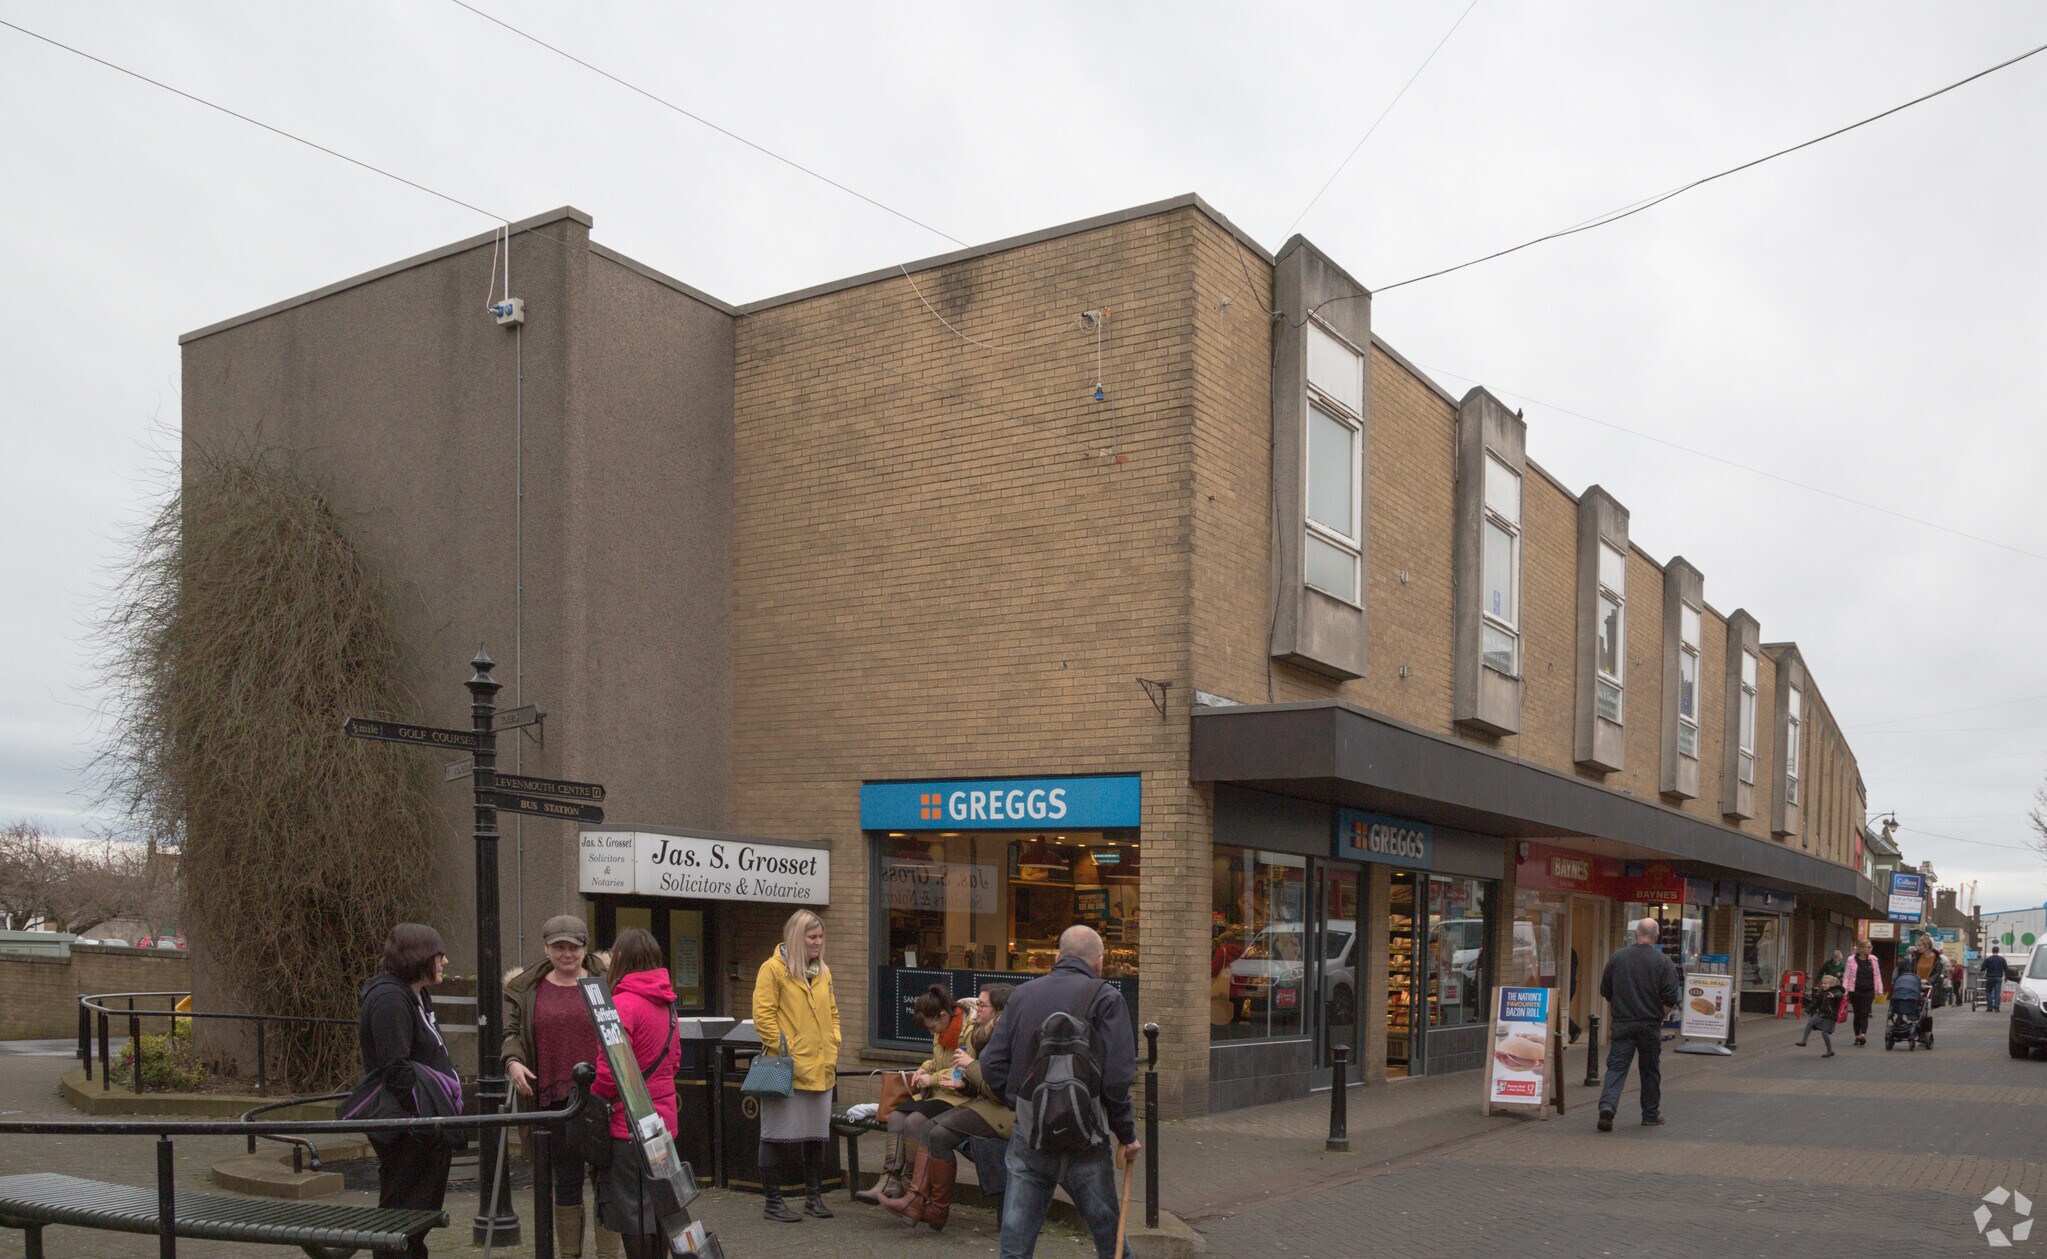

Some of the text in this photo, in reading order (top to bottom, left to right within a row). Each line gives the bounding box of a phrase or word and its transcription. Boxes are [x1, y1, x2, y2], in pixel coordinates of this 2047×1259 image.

[359, 724, 379, 735] mile
[399, 727, 477, 746] GOLF COURSES
[496, 778, 590, 796] LEVENMOUTH CENTRE
[520, 800, 580, 816] BUS STATION
[948, 788, 1067, 821] GREGGS
[581, 836, 632, 849] Jas. S. Grosset
[1368, 823, 1424, 859] GREGGS
[588, 853, 625, 864] Solicitors
[651, 839, 817, 876] Jas. S. Grosset
[604, 866, 611, 875] &
[591, 877, 625, 888] Notaries
[660, 872, 811, 899] Solicitors & Notaries
[1896, 878, 1917, 886] Colliers
[584, 983, 605, 1006] Will
[1507, 991, 1542, 1002] THE NATION'S
[593, 1006, 621, 1023] Suffering
[1505, 1007, 1540, 1018] BACON ROLL
[600, 1022, 624, 1046] End?
